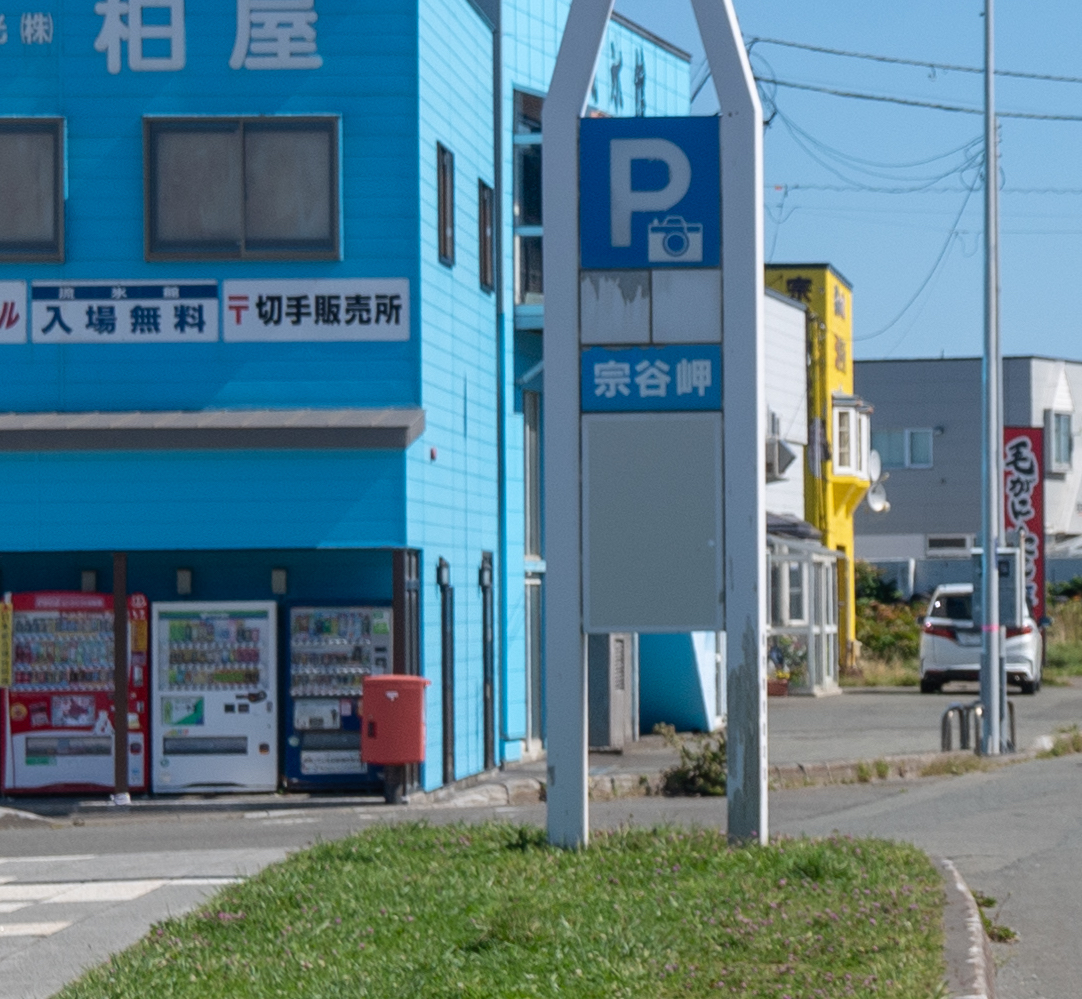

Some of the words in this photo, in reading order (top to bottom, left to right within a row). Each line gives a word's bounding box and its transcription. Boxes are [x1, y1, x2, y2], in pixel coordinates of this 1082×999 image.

[609, 138, 692, 248] P
[41, 305, 207, 334] 入場無料
[593, 359, 712, 398] 宗谷岬
